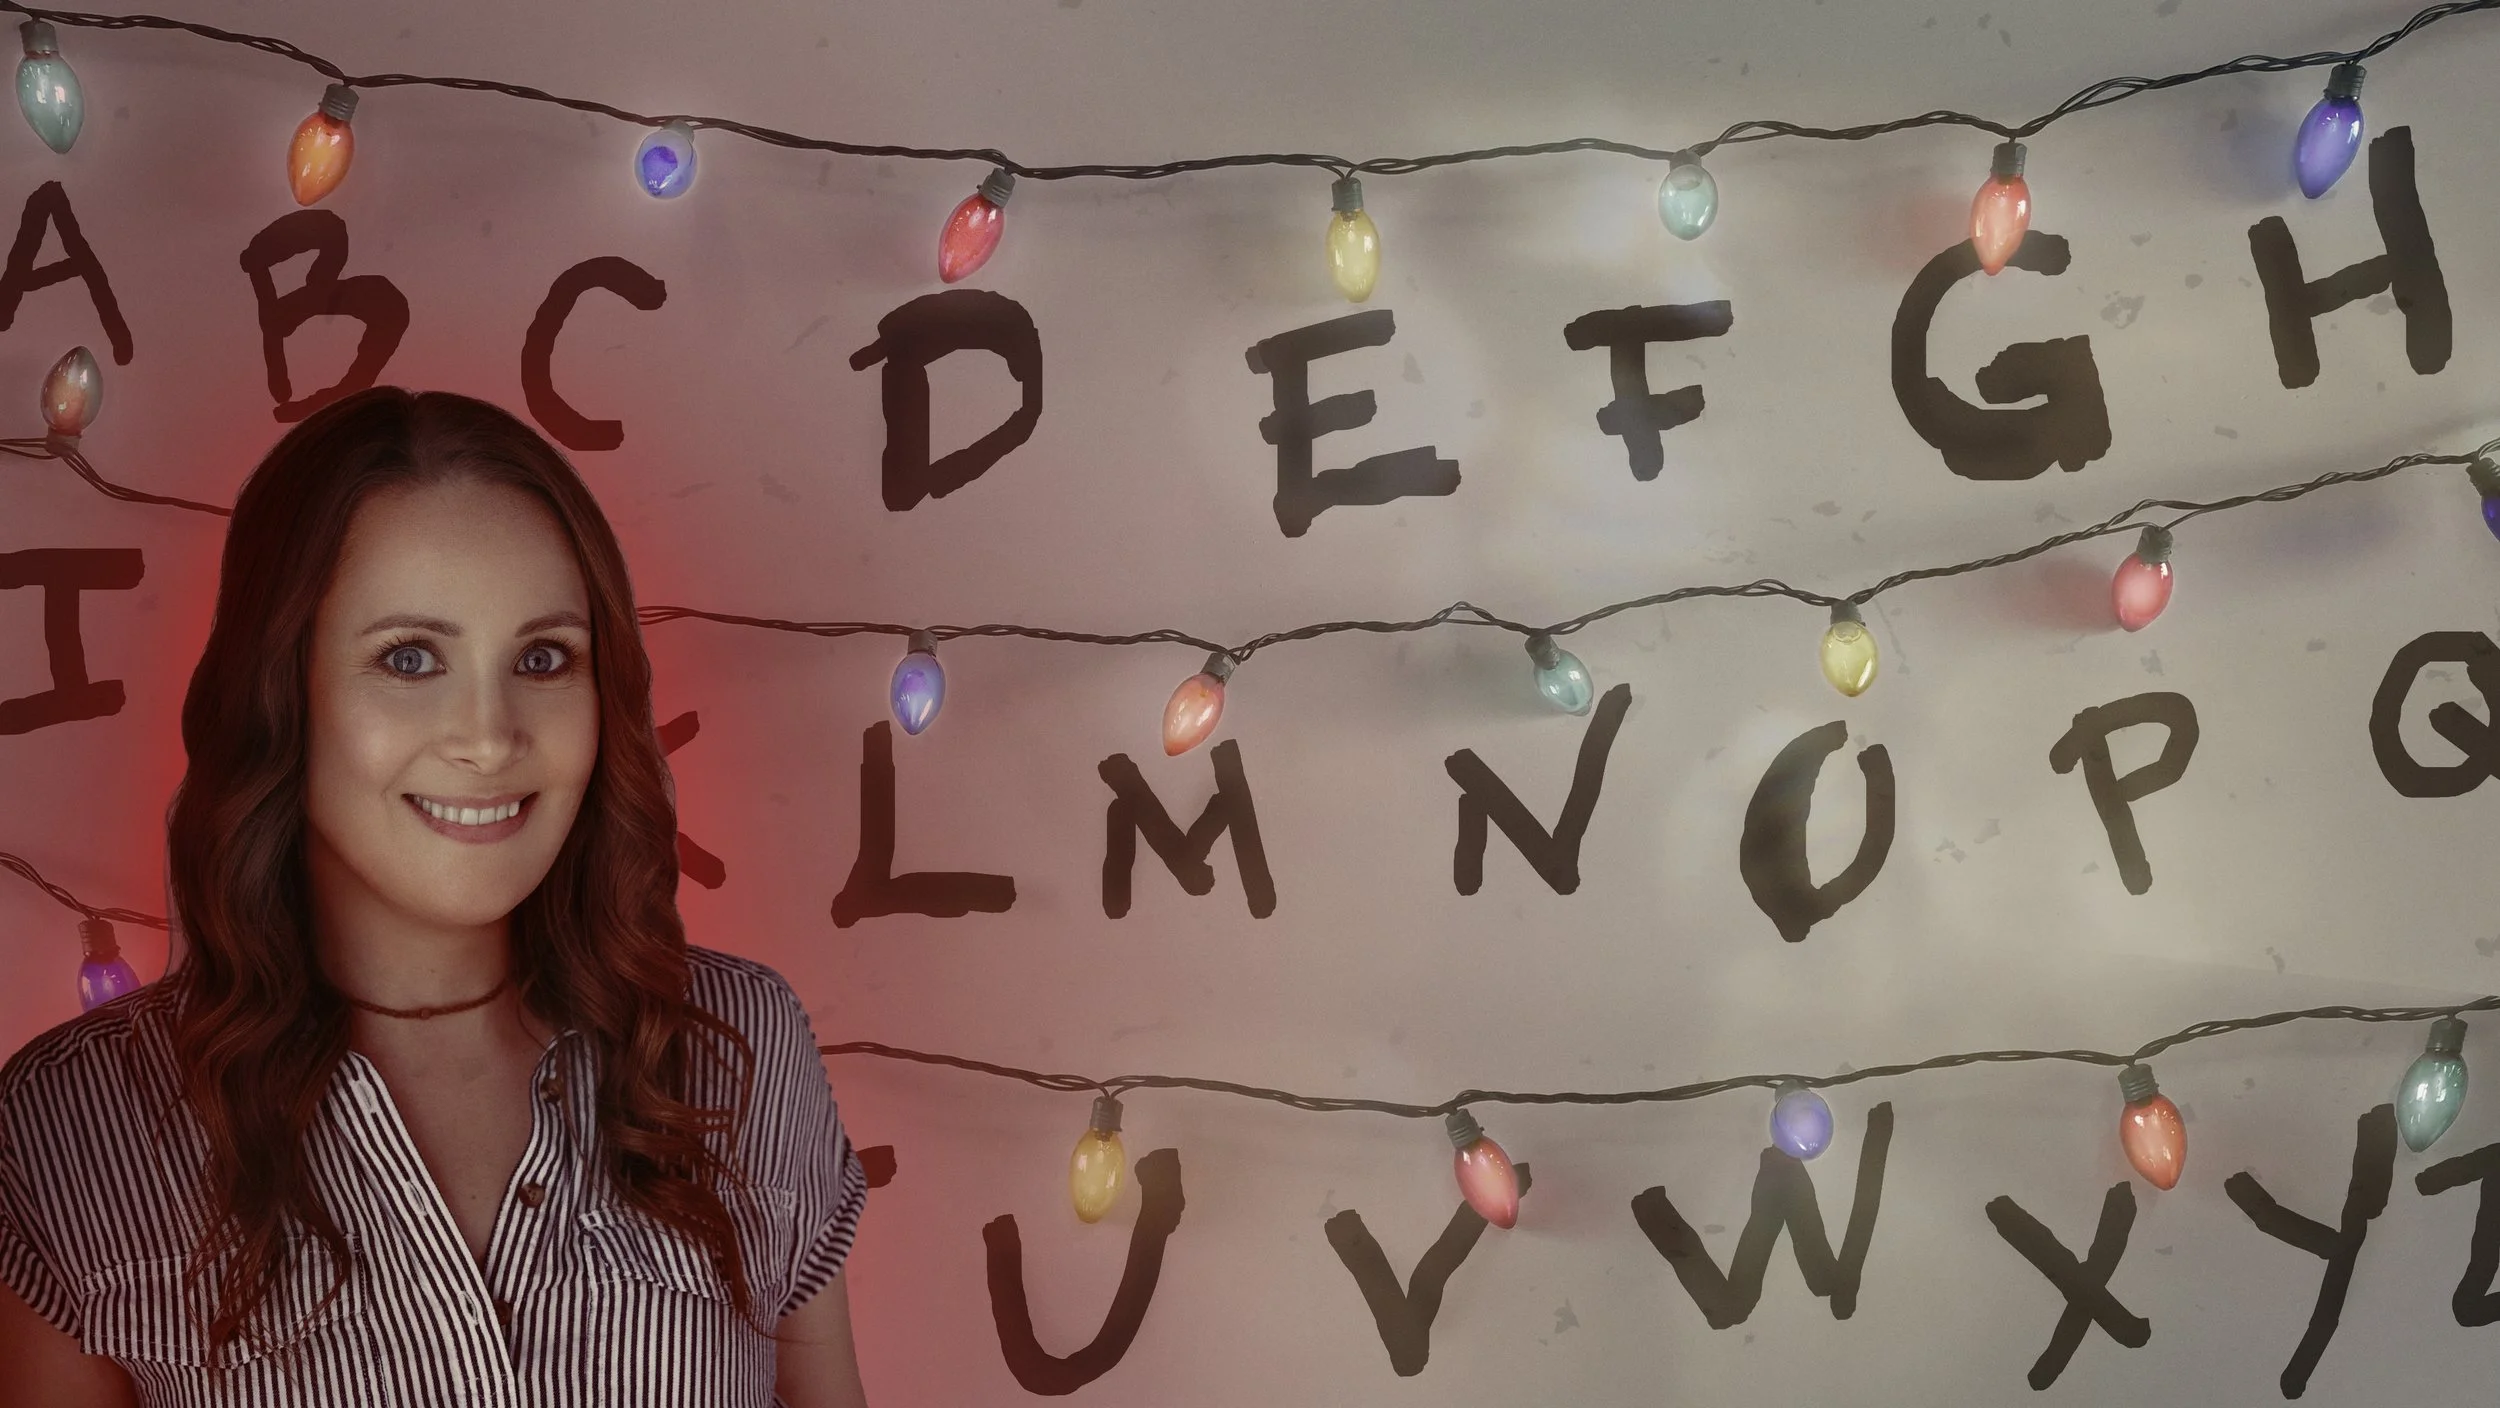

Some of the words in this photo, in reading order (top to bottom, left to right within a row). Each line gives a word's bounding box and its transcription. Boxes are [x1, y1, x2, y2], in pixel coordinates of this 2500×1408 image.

[0, 181, 133, 365] A
[240, 210, 410, 424] B
[521, 256, 667, 451] C
[847, 289, 1043, 512] D
[1245, 310, 1462, 538] E
[1564, 300, 1733, 481] F
[1891, 230, 2112, 481] G
[2248, 126, 2453, 389] H
[0, 548, 145, 736] I
[831, 720, 1017, 928] L
[1098, 739, 1277, 919] M
[1445, 683, 1633, 896] N
[1740, 720, 1895, 943] O
[2049, 692, 2200, 895] P
[2369, 631, 2500, 798] Q
[982, 1148, 1185, 1396] U
[1324, 1162, 1532, 1377] V
[1631, 1101, 1894, 1330] W
[1985, 1181, 2151, 1391] X
[2225, 1104, 2397, 1400] Y
